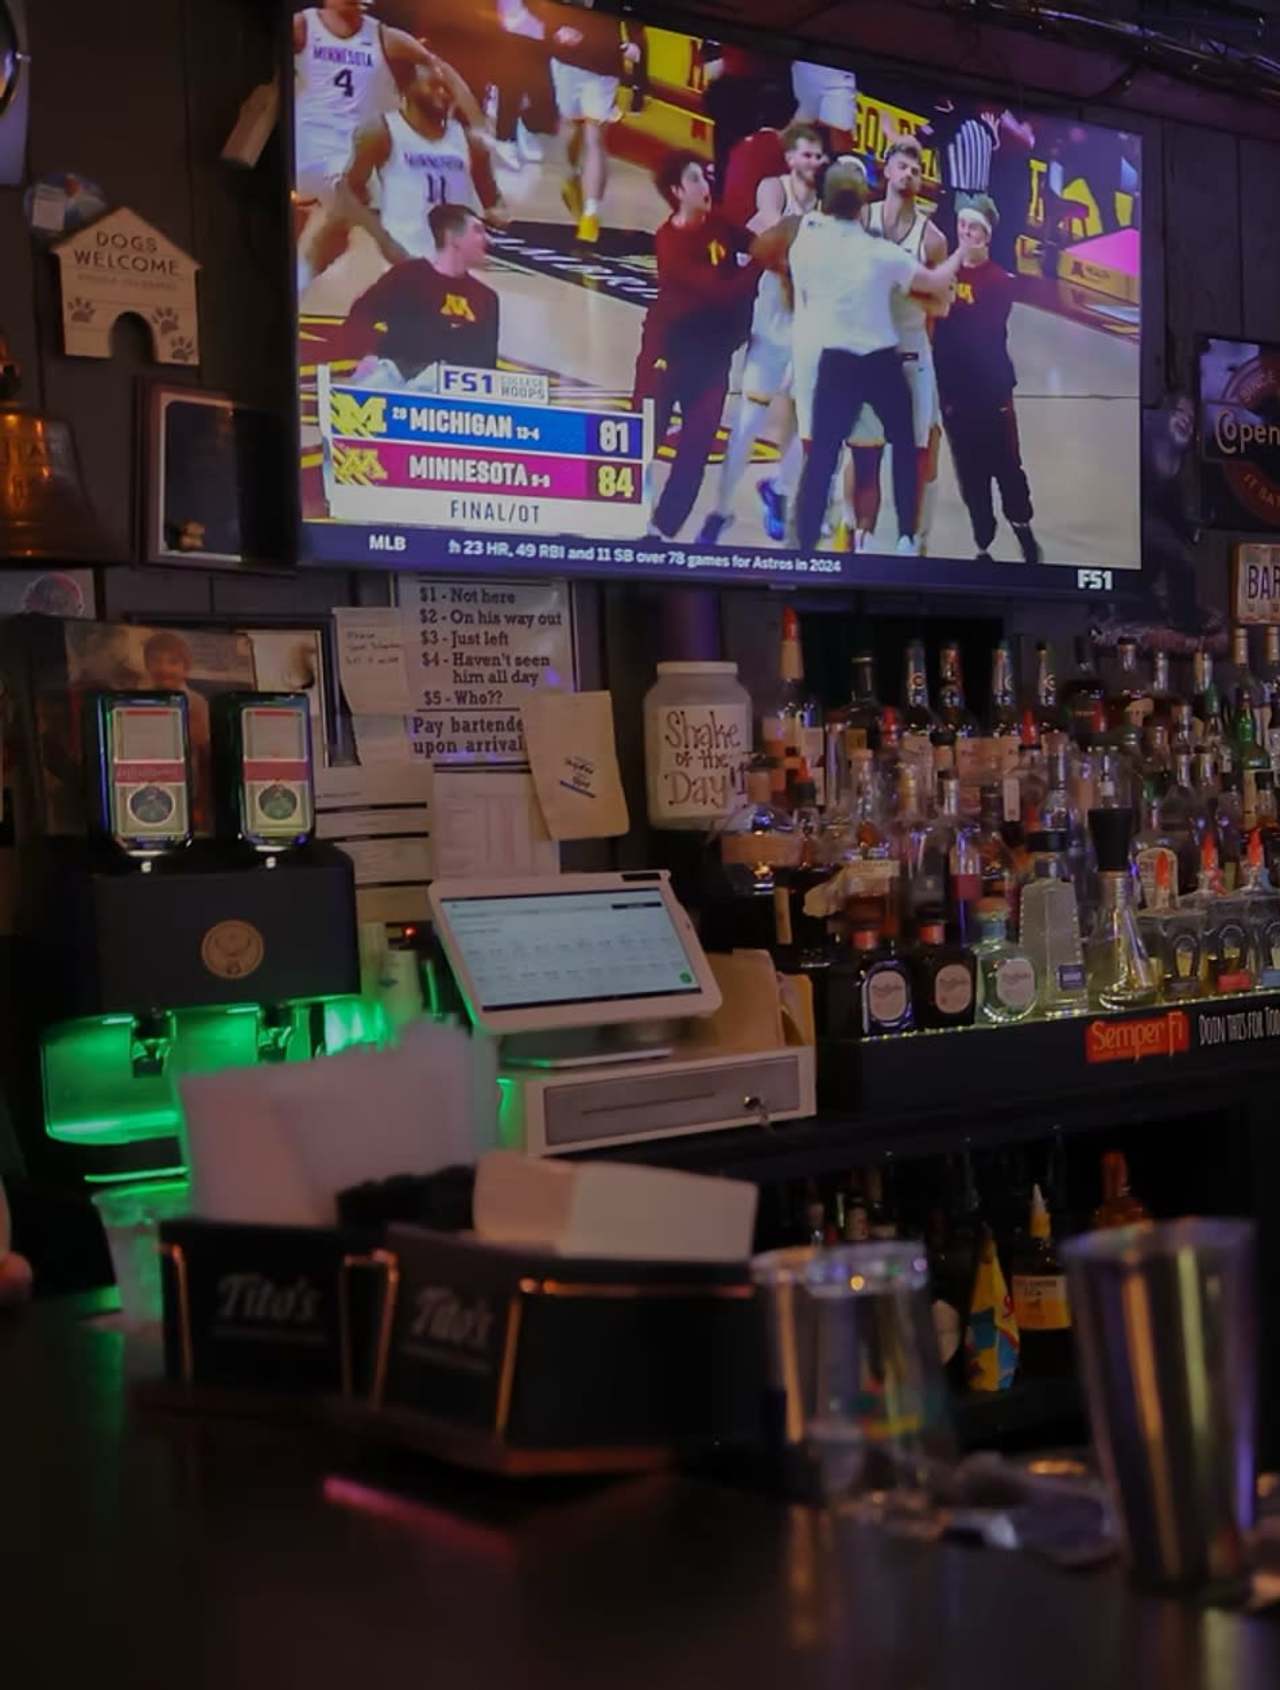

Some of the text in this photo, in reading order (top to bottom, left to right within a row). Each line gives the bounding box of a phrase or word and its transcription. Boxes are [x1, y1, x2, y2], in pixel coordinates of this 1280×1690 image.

[334, 69, 354, 98] 4
[426, 173, 447, 204] 11
[96, 231, 158, 252] DOGS
[74, 249, 181, 276] WELCOME
[444, 370, 494, 394] FS1
[501, 386, 545, 400] HOOPS
[410, 407, 513, 439] MICHIGAN
[409, 455, 634, 498] MINNESOTA 84
[450, 500, 541, 525] FINAL/OT
[369, 533, 407, 551] MLB
[463, 541, 483, 555] 23
[515, 542, 536, 557] 49
[539, 543, 564, 558] RBI
[567, 545, 594, 561] and
[614, 548, 634, 562] SB
[636, 552, 665, 564] over
[687, 554, 730, 568] games
[732, 554, 749, 568] for
[752, 556, 793, 570] Astros
[795, 558, 807, 570] in
[809, 559, 842, 572] 2024
[1077, 568, 1114, 591] FS1
[419, 586, 516, 605] $1 Not here
[419, 610, 563, 629] $2 On his way out
[420, 631, 510, 648] $3 Just left
[421, 653, 550, 668] $4 Haven't seen
[453, 669, 540, 687] him all day
[424, 690, 503, 706] $5 Who??
[412, 716, 524, 741] Pay bartende
[664, 710, 742, 750] Shake
[413, 735, 524, 758] upon arrival
[675, 750, 729, 770] of the
[1090, 1010, 1184, 1064] Semper Fi
[216, 1271, 325, 1323] Tito's
